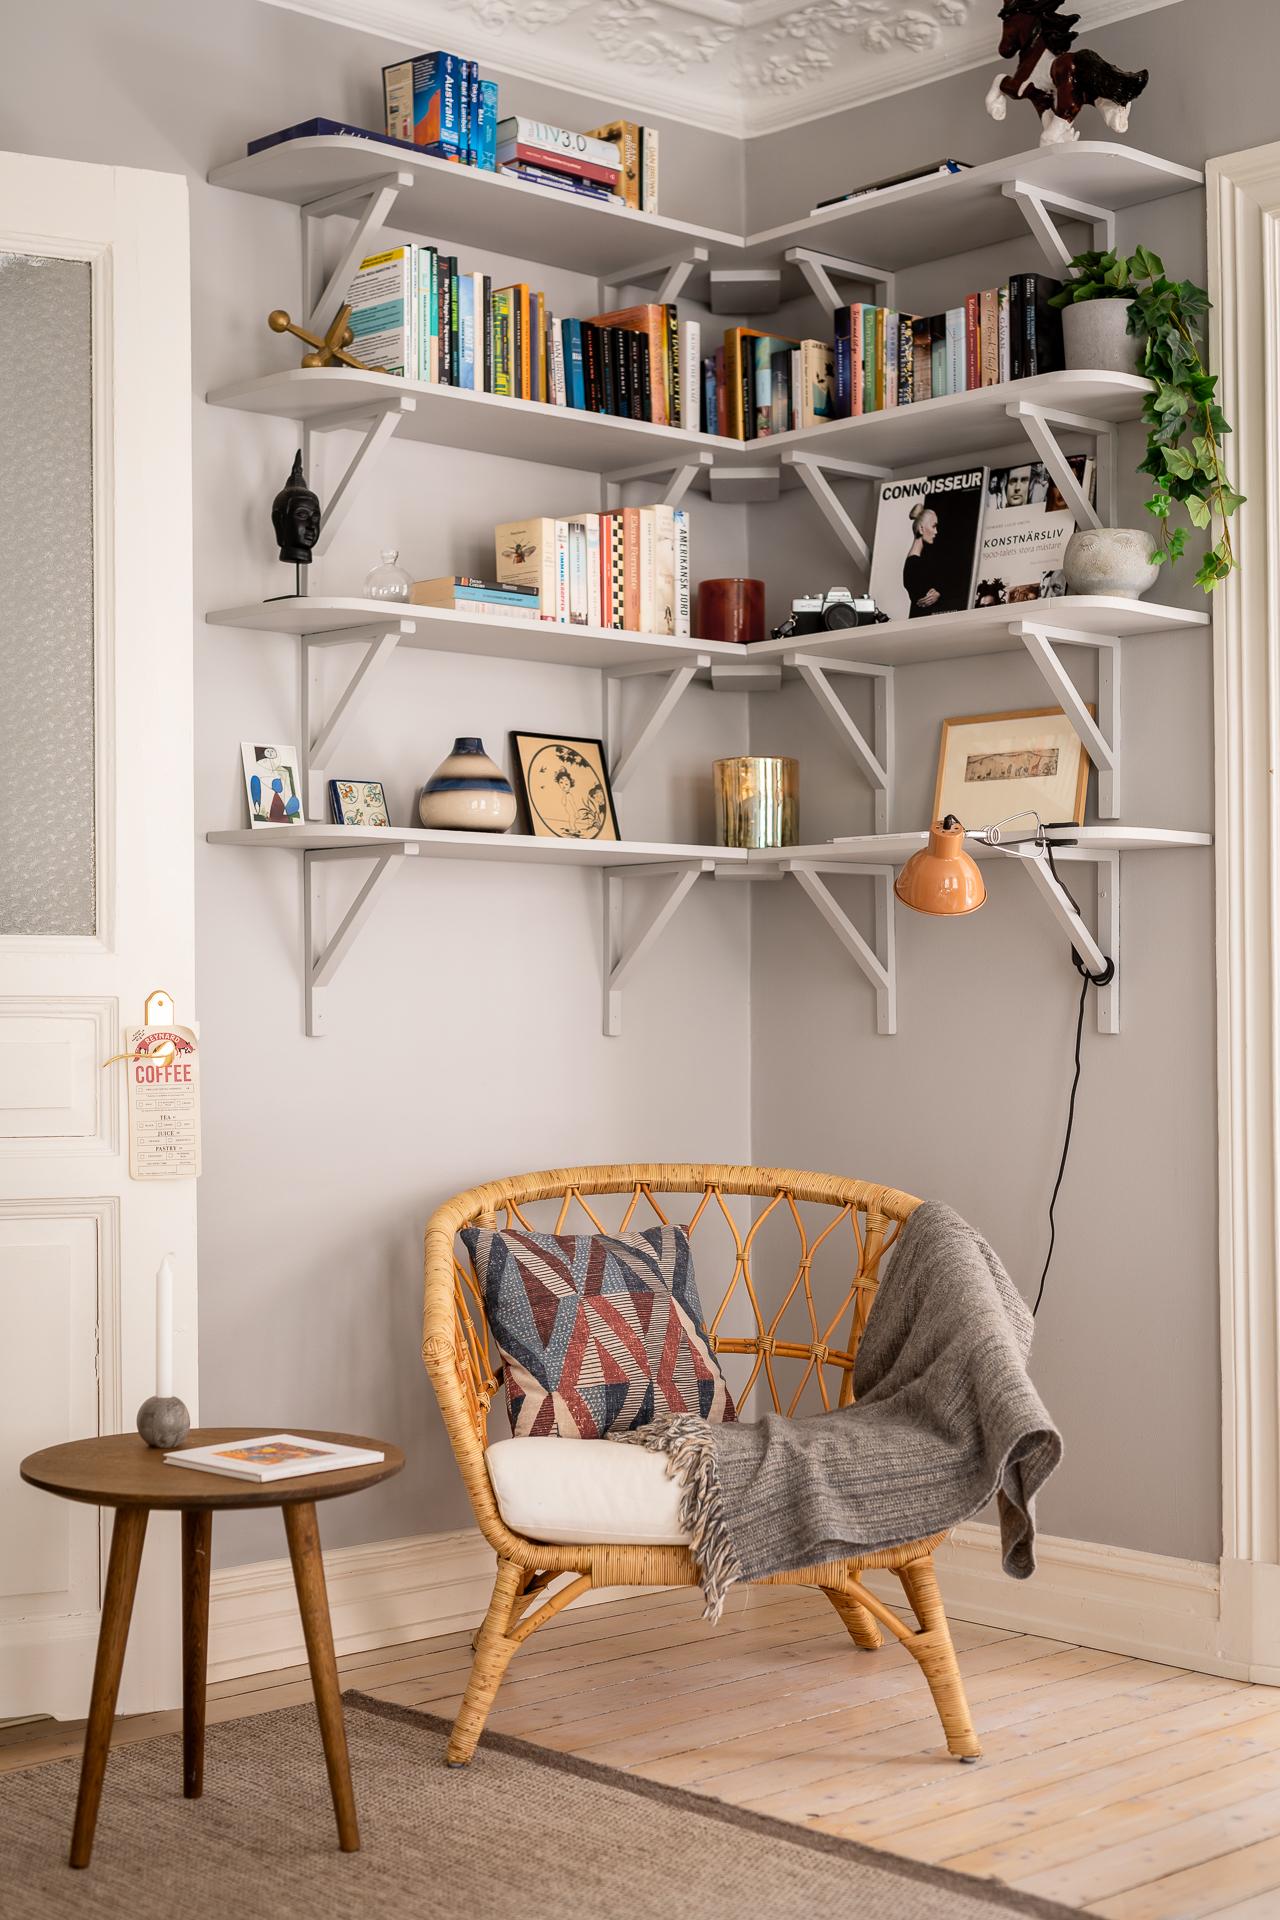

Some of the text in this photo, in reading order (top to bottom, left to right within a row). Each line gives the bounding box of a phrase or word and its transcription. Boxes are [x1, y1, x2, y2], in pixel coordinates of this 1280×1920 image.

[444, 75, 454, 128] Australia
[882, 472, 982, 501] CONNOISSEUR
[630, 515, 639, 590] Elena Ferrante
[983, 528, 1064, 548] KONSTNÄRSLIV
[679, 529, 689, 616] AMERIKANSK JORD
[144, 1033, 181, 1044] REYNARD
[135, 1064, 192, 1084] COFFEE
